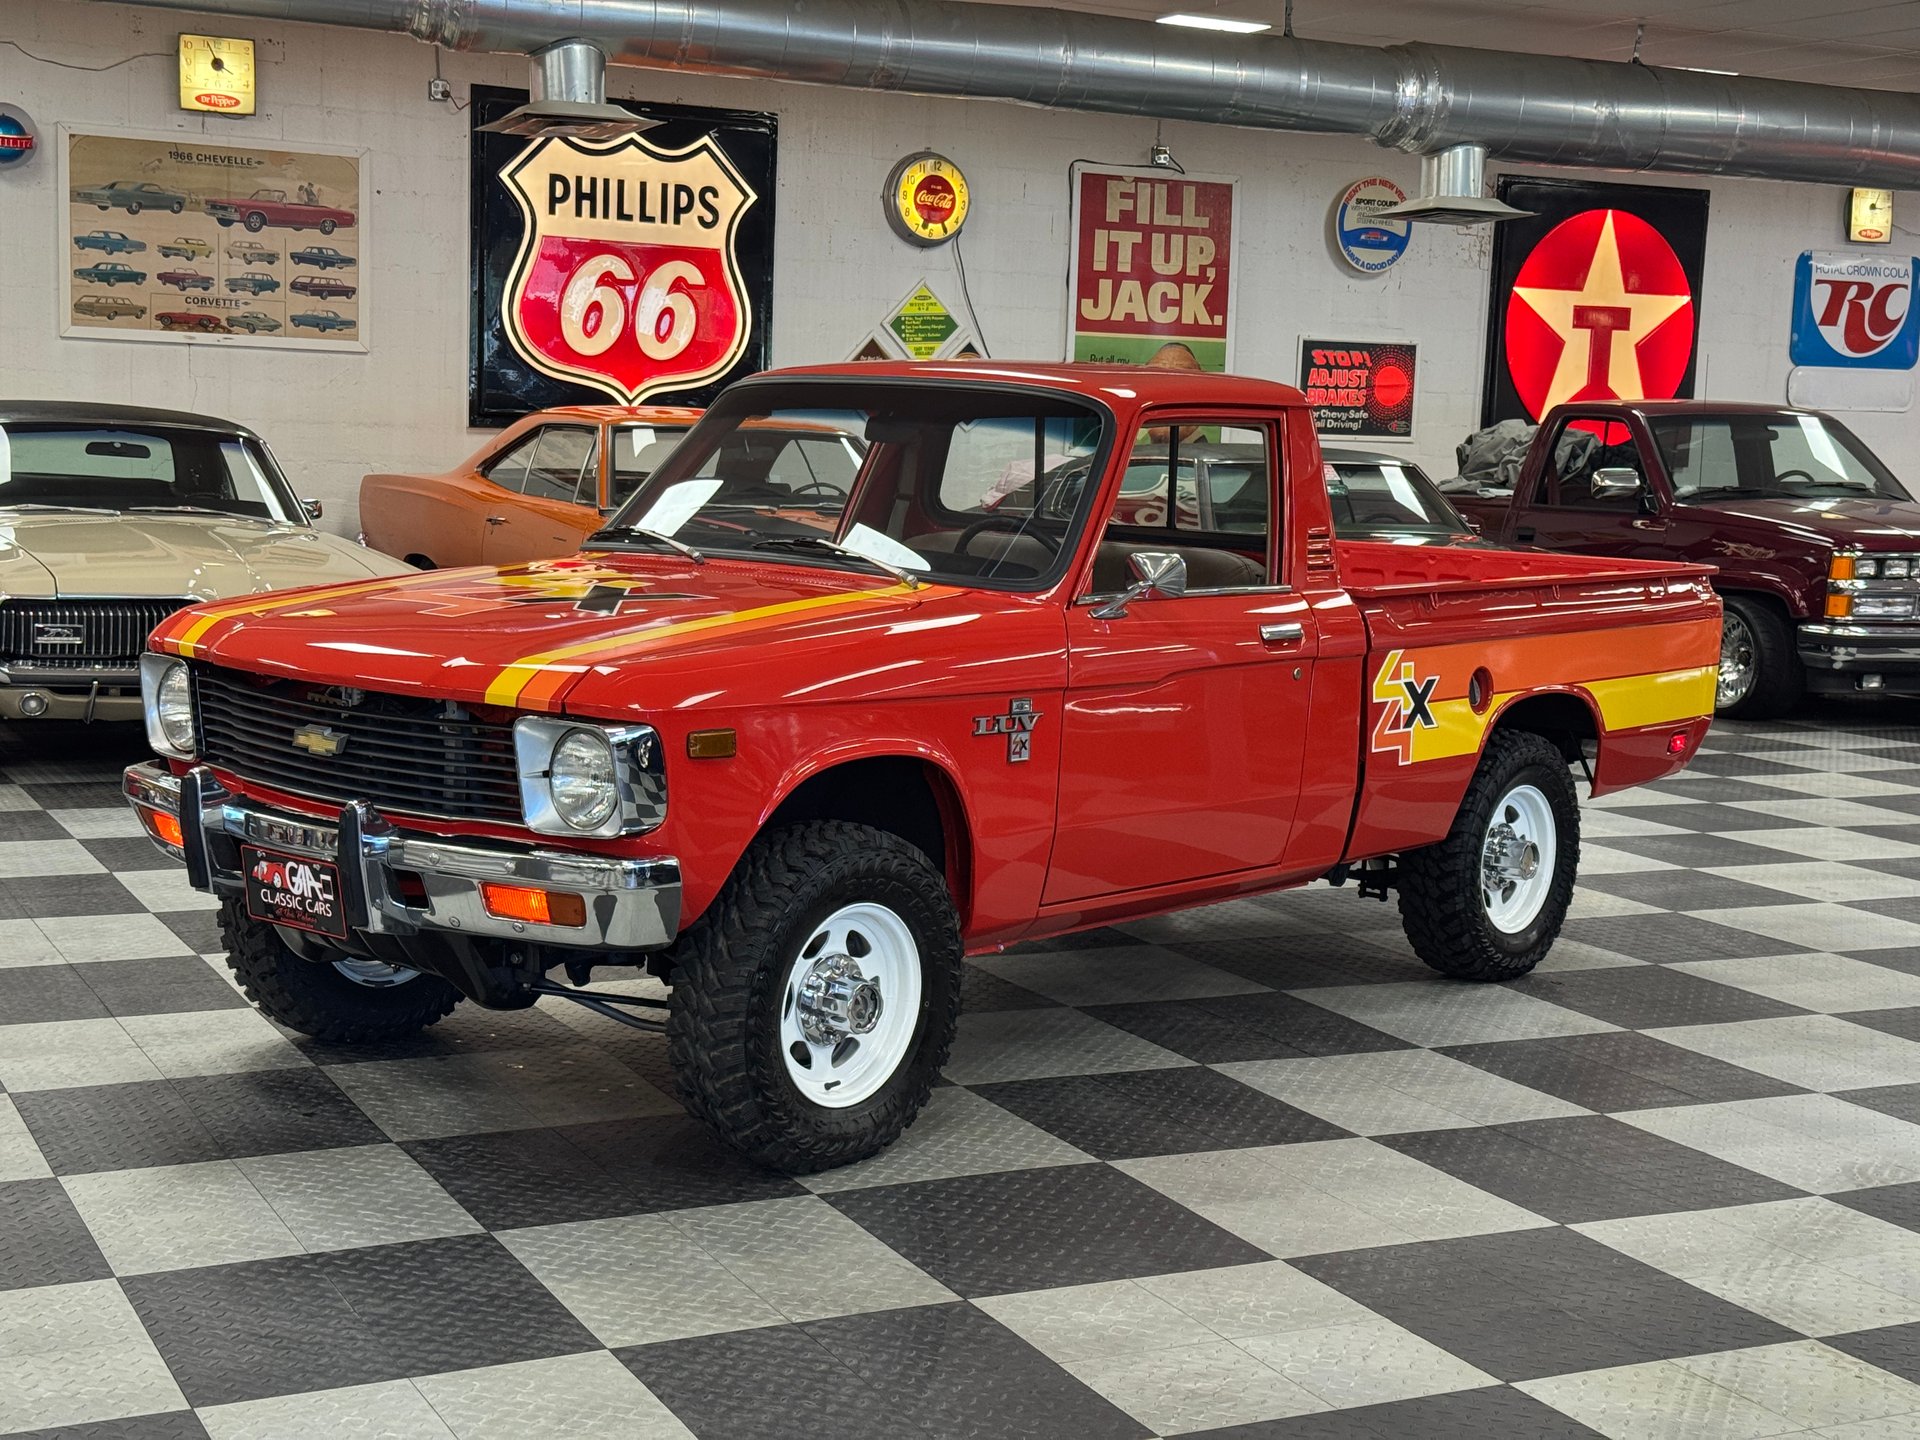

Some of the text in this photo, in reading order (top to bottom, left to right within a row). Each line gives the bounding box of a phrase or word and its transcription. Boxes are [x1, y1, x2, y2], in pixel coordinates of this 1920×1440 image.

[211, 95, 236, 106] Pepper
[168, 151, 193, 160] 1966
[196, 153, 253, 166] CHEVELLE
[919, 163, 925, 174] 11
[934, 161, 942, 171] 12
[906, 175, 915, 185] 10
[1362, 179, 1377, 188] THE
[1379, 179, 1396, 191] NEW
[959, 183, 964, 193] 2
[548, 173, 720, 230] PHILLIPS
[902, 190, 908, 200] 9
[961, 200, 966, 210] 3
[1106, 179, 1210, 228] FILL
[905, 207, 910, 217] 8
[915, 223, 919, 232] 7
[928, 228, 933, 238] 6
[1093, 229, 1216, 282] IT UP,
[1345, 247, 1361, 265] HAVE
[1361, 261, 1366, 269] A
[1366, 262, 1387, 271] GOOD
[1847, 265, 1881, 277] CROWN
[1883, 267, 1910, 278] COLA
[185, 296, 240, 307] CORVETTE
[561, 254, 706, 361] 66
[1081, 279, 1223, 326] JACK.
[1815, 279, 1909, 354] RC
[1311, 349, 1372, 367] STOP!
[1308, 368, 1369, 387] ADJUST
[1307, 388, 1367, 407] BRAKES
[1314, 419, 1362, 430] all Driving!
[973, 712, 1044, 735] LUV
[260, 888, 332, 918] CLASSIC CARS
